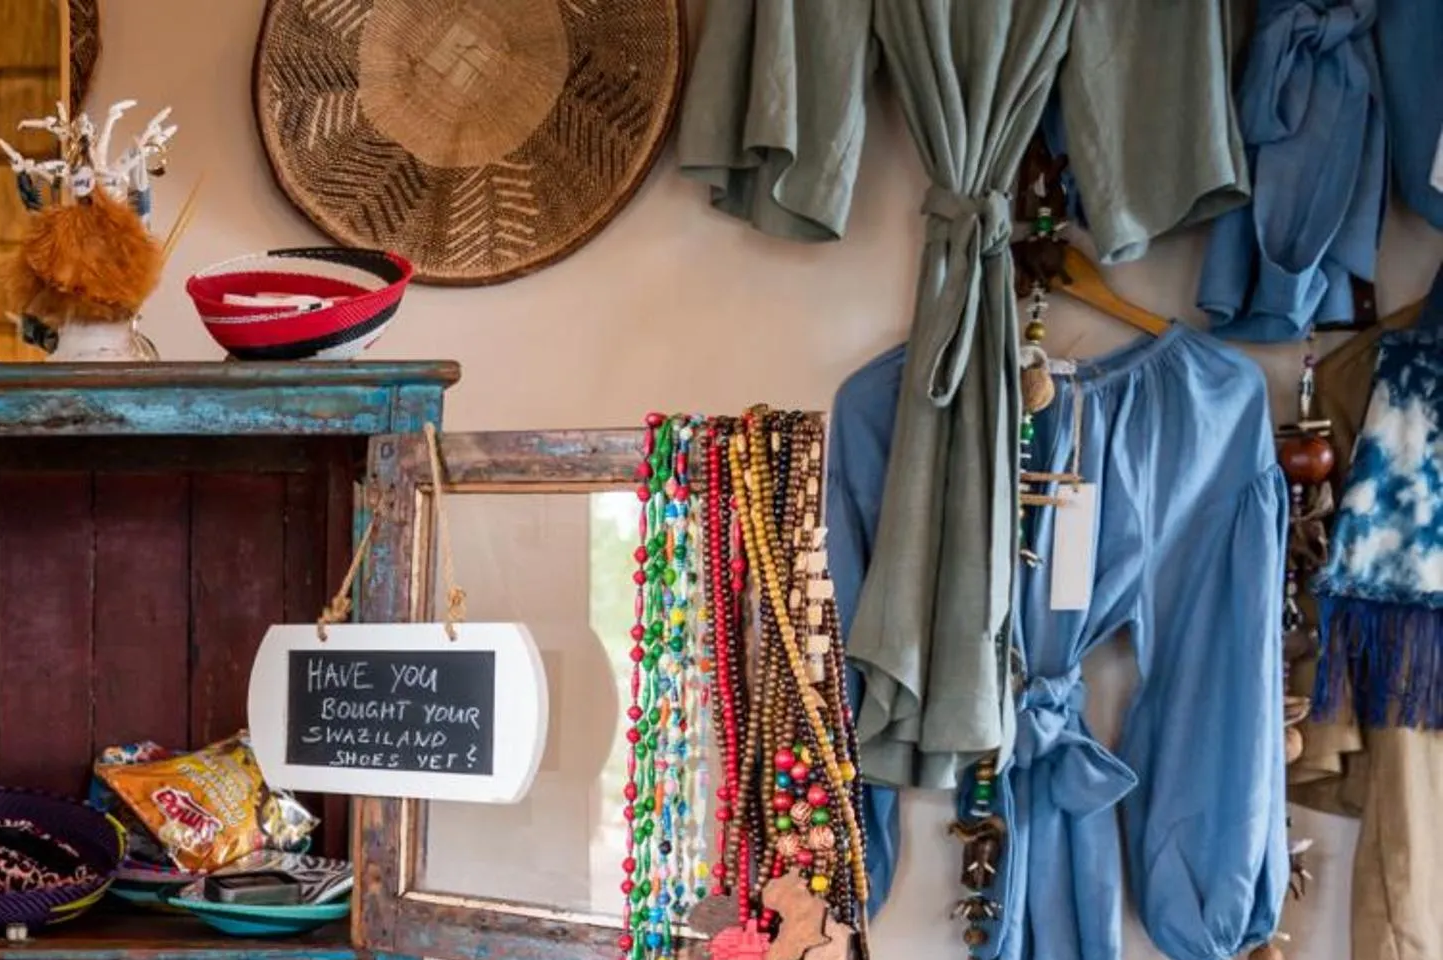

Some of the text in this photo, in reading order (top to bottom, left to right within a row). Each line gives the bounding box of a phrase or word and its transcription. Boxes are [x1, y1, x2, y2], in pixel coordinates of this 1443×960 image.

[307, 657, 438, 693] HAVE YOU
[320, 697, 481, 730] BOUGHT YOUR
[301, 726, 447, 748] SWAZILAND
[329, 751, 400, 768] SHOES
